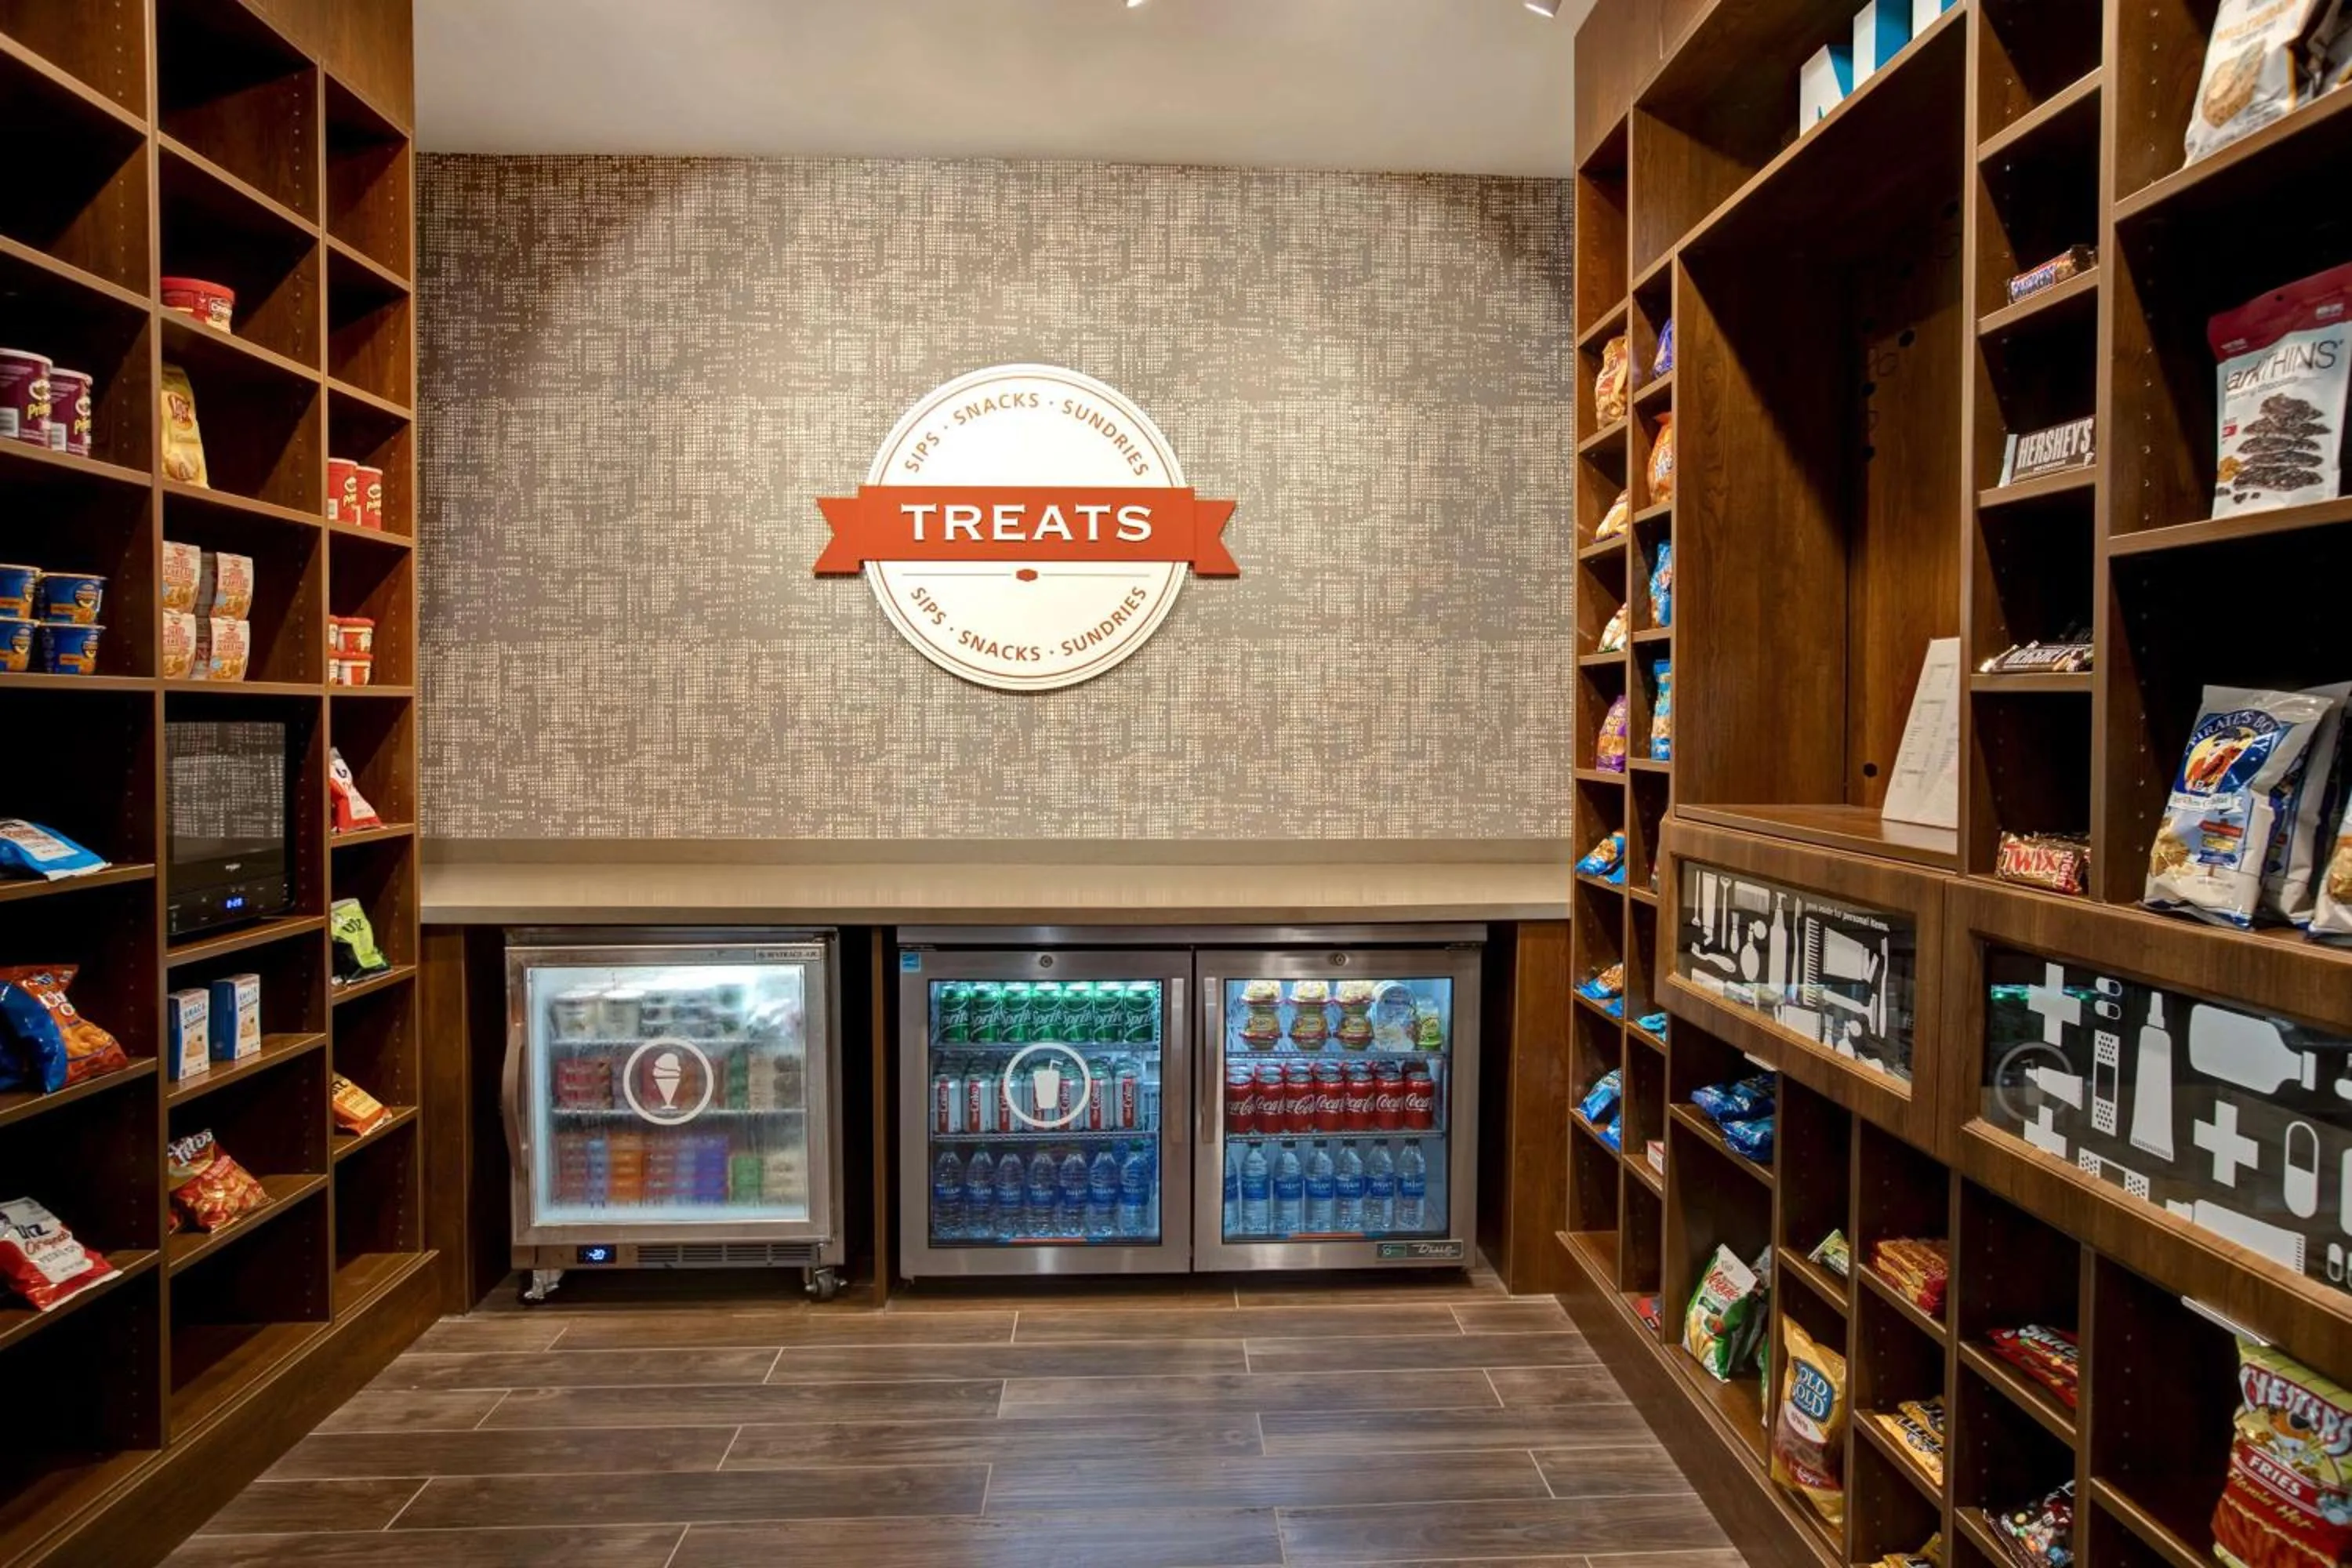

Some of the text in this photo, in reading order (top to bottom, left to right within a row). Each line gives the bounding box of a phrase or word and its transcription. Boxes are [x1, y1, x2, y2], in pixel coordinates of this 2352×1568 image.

[905, 393, 1149, 477] SIPS SNACKS SUNDRIES
[2016, 418, 2094, 470] HERSHEY'S
[901, 503, 1152, 542] TREATS
[911, 586, 1147, 661] SIPS SNACKS SUNDRIES
[2003, 843, 2057, 874] TWIX
[1842, 911, 1870, 927] personal
[1125, 1010, 1152, 1028] Sprit
[16, 1225, 50, 1239] Utz
[1800, 1367, 1828, 1396] OLD
[1795, 1384, 1825, 1417] OLD
[2249, 1455, 2301, 1497] FRIES
